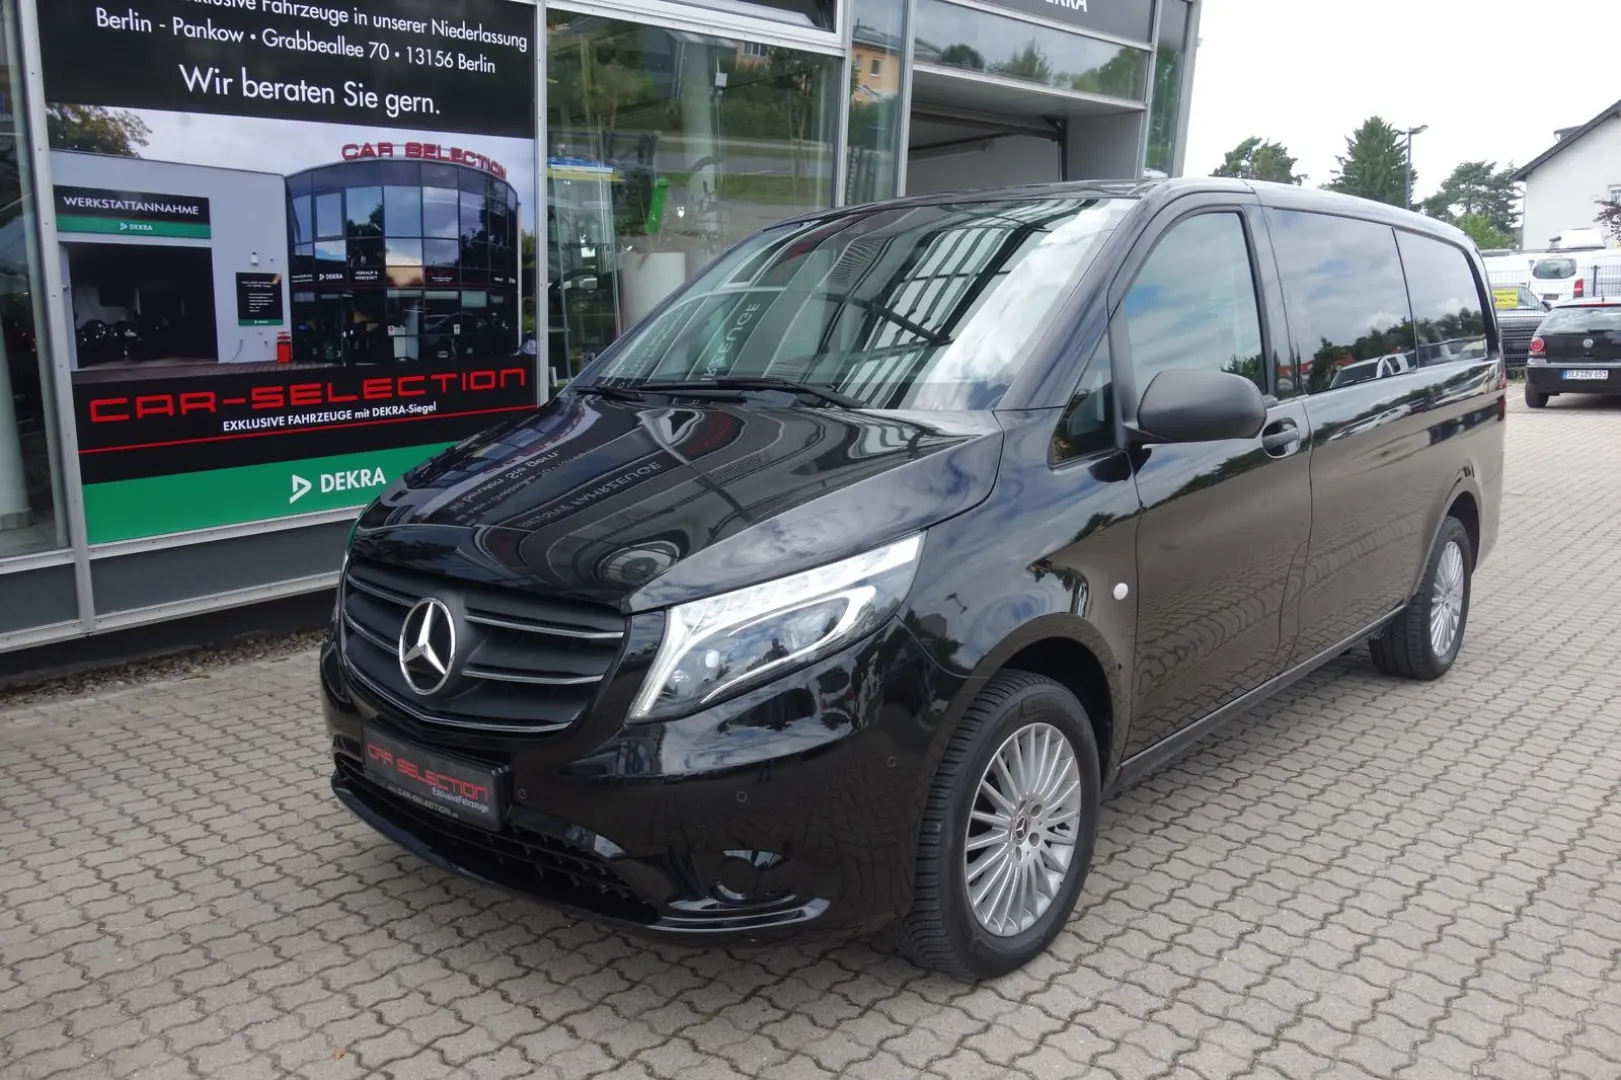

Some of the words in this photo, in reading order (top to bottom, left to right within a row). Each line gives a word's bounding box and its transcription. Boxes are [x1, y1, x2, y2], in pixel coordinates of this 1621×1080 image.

[95, 6, 152, 33] Berlin
[172, 16, 245, 43] Pankow
[262, 28, 364, 58] Grabbeallee
[368, 41, 390, 61] 70
[406, 46, 454, 69] 13156
[458, 53, 496, 74] Berlin
[184, 0, 257, 10] usive
[262, 0, 349, 27] Fahrzeuge
[353, 7, 368, 26] in
[373, 14, 427, 34] unserer
[431, 18, 528, 52] Niederlassung
[178, 64, 233, 95] Wir
[241, 66, 335, 105] beraten
[344, 80, 378, 109] Sie
[385, 92, 441, 118] gern.
[341, 142, 393, 160] CAR
[405, 142, 507, 179] SELECTION
[63, 195, 199, 215] WERKSTATTANNAHME
[129, 223, 153, 231] DEKRA
[90, 368, 526, 423] CAR-SELECTION
[223, 415, 286, 432] EXKLUSIVE
[288, 410, 352, 426] FAHRZEUGE
[355, 408, 370, 419] mit
[372, 401, 437, 418] DEKRA-Siegel
[320, 467, 387, 494] DEKRA
[367, 744, 393, 767] CAR
[397, 757, 489, 802] SELECTION
